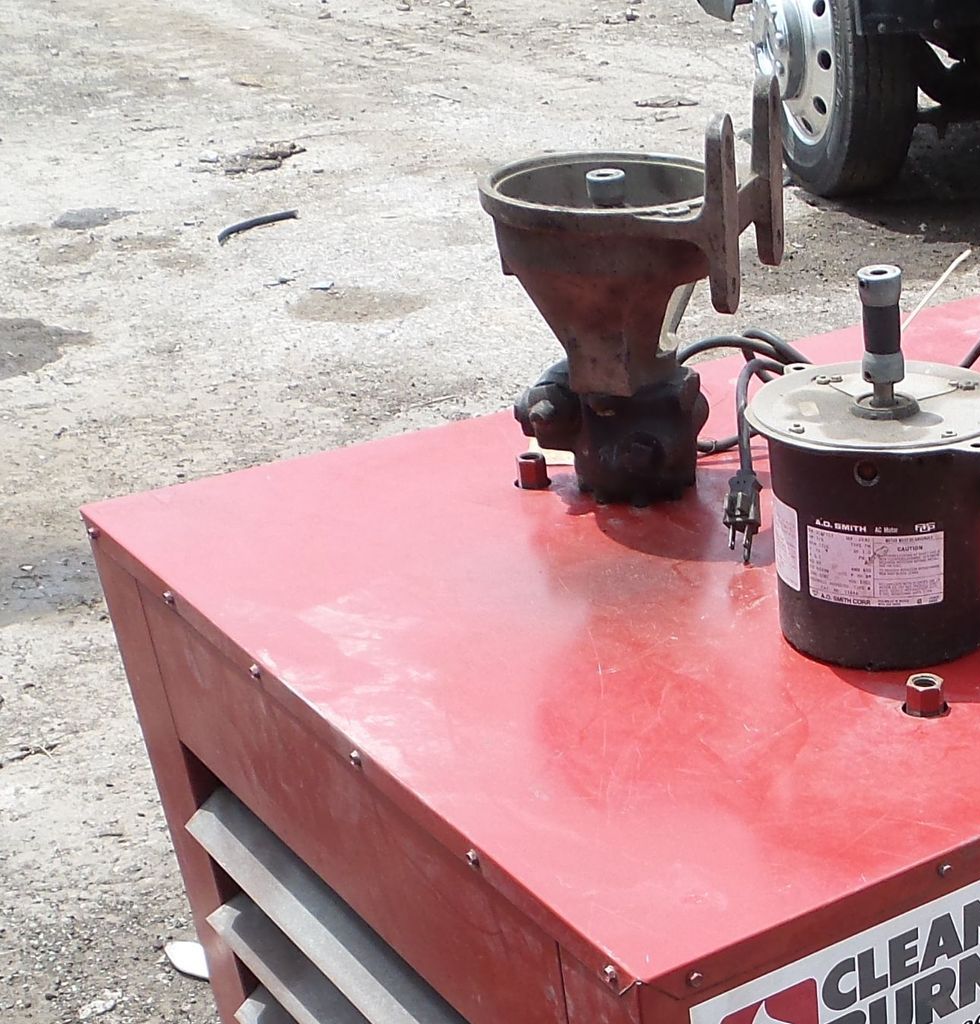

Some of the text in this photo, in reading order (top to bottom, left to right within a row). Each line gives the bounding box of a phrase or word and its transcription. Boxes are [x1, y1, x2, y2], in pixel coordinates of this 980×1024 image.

[815, 518, 833, 529] A.O.
[834, 522, 866, 533] SMITH
[833, 596, 852, 604] SMITH
